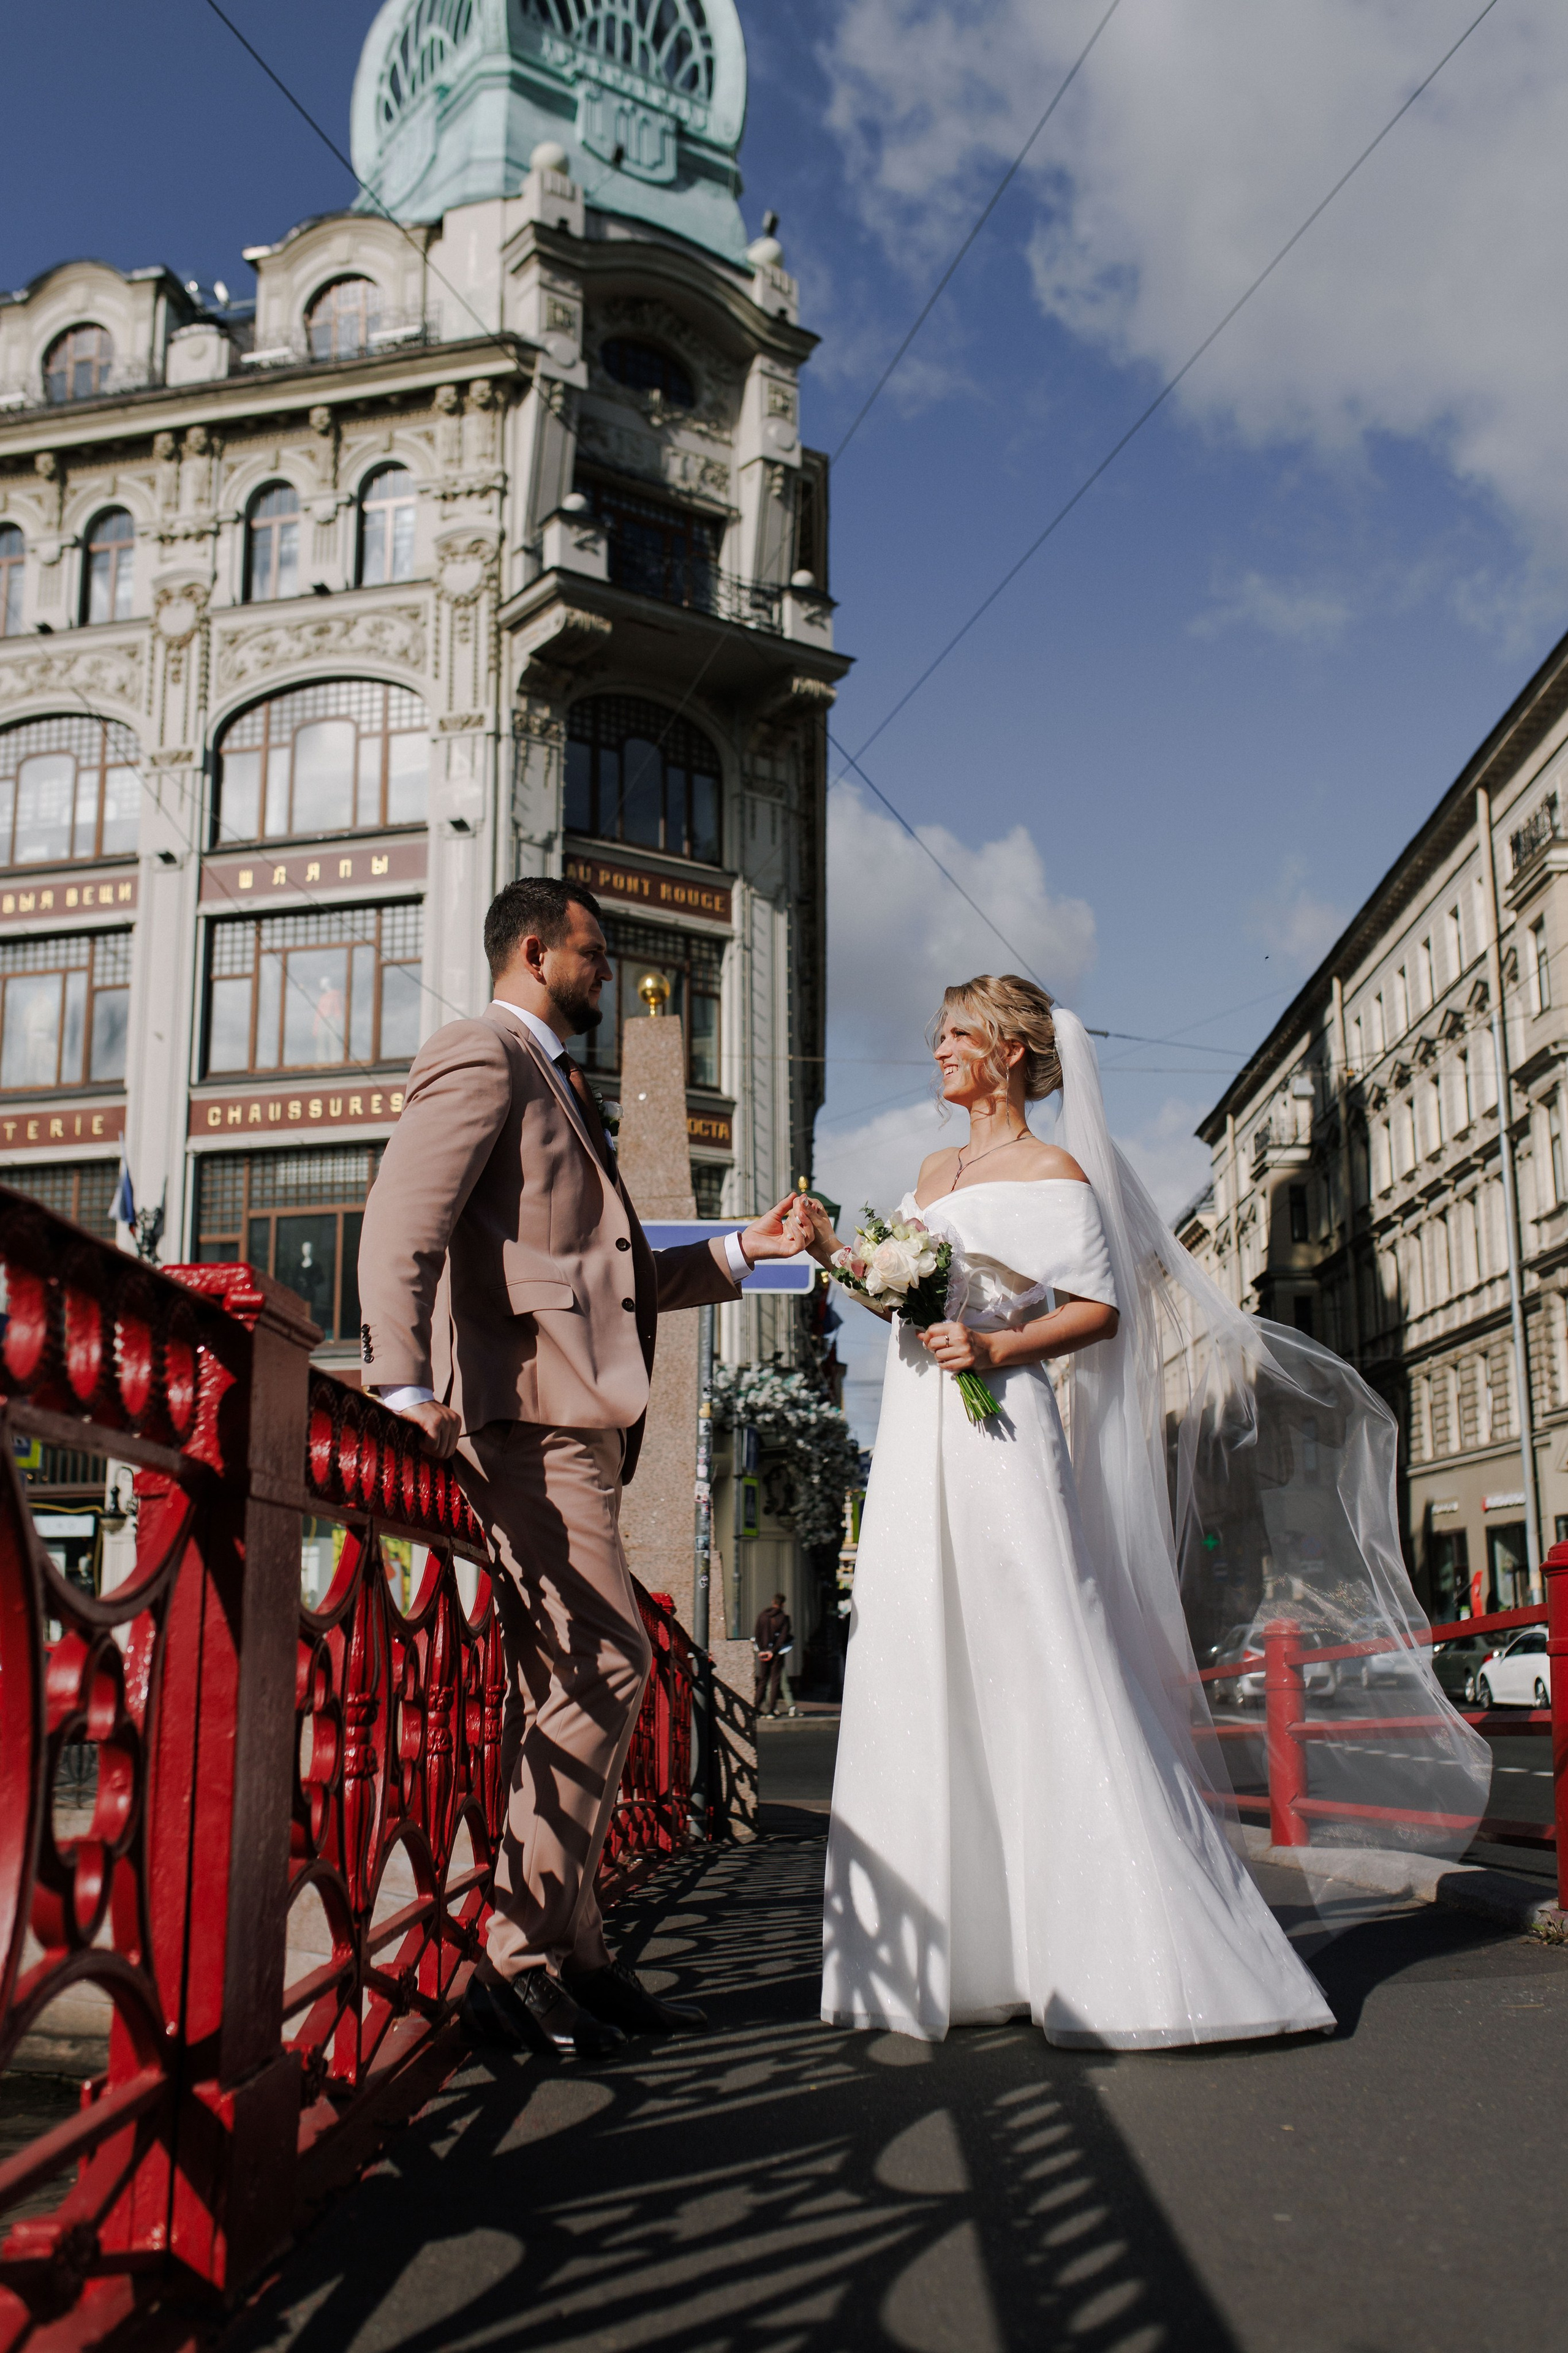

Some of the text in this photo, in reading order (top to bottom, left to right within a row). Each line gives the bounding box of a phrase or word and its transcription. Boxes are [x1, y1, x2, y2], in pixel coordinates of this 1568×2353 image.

[238, 855, 388, 889] ШЛЯПЫ
[567, 863, 726, 913] AU PONT ROUGE
[66, 881, 132, 907] ВЕЩИ
[207, 1092, 405, 1127] CHAUSSURES
[2, 1114, 105, 1142] TERIE
